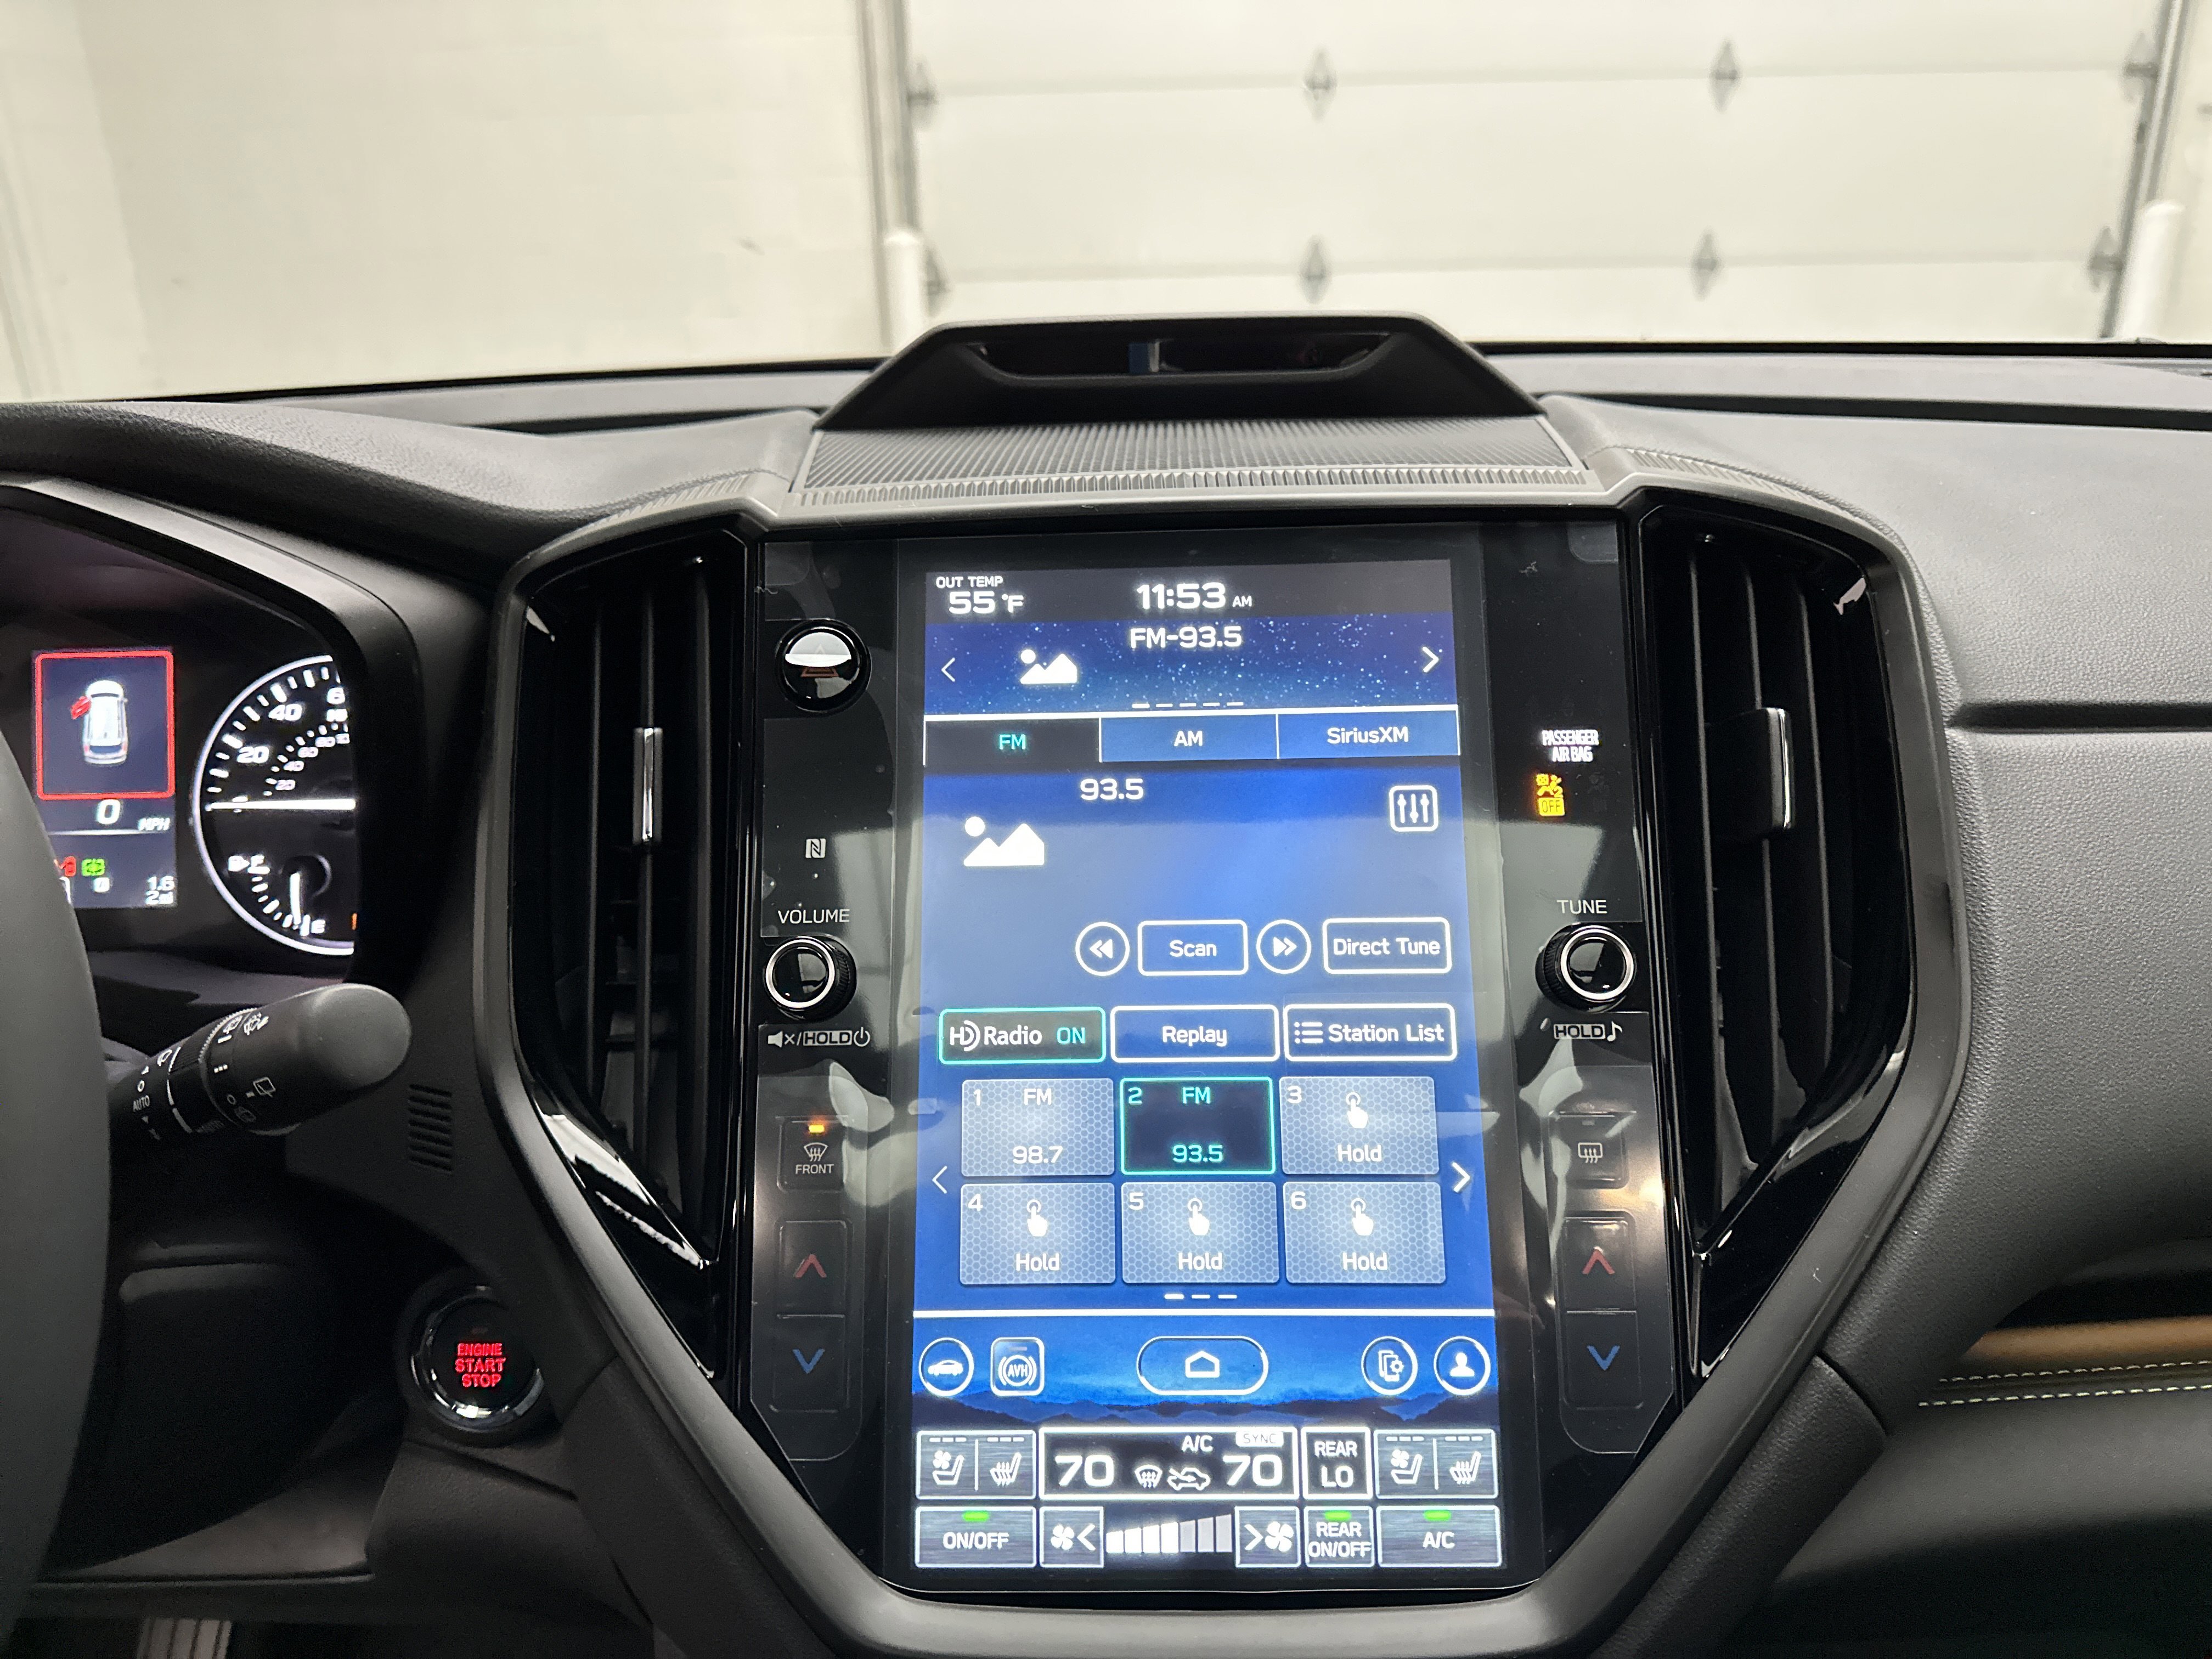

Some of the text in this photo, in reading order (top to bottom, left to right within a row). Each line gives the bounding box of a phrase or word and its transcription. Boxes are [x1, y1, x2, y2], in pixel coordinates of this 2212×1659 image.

[935, 575, 1003, 589] OUT TEMP
[949, 590, 996, 614] 55
[1136, 582, 1252, 610] 11:53 AM
[1130, 625, 1242, 649] FM-93.5
[268, 703, 302, 721] 40
[999, 733, 1026, 750] FM
[1173, 730, 1203, 747] AM
[1327, 726, 1409, 744] SiriusXM
[1542, 729, 1599, 746] PASSENGER
[237, 746, 270, 764] 20
[1552, 746, 1593, 762] AIR BAG
[1080, 778, 1144, 800] 93.5
[96, 799, 121, 825] 0
[1542, 800, 1561, 813] OFF
[138, 817, 171, 831] MPH
[1556, 899, 1607, 915] TUNE
[777, 909, 850, 924] VOLUME
[1170, 940, 1217, 957] Scan
[1333, 937, 1441, 956] Direct Tune
[805, 1031, 850, 1045] HOLD
[984, 1024, 1042, 1046] Radio
[1057, 1026, 1086, 1045] ON
[1162, 1025, 1227, 1047] Replay
[1328, 1024, 1444, 1042] Station List
[1555, 1025, 1604, 1038] HOLD
[132, 1095, 151, 1112] AUTO
[973, 1088, 981, 1107] 1
[1023, 1088, 1052, 1105] FM
[1128, 1087, 1143, 1104] 2
[1182, 1086, 1211, 1104] FM
[1285, 1085, 1302, 1104] 3
[1012, 1145, 1063, 1164] 98.7
[1172, 1144, 1223, 1163] 93.5
[1337, 1143, 1383, 1163] Hold
[795, 1164, 834, 1175] FRONT
[968, 1193, 984, 1211] 4
[1127, 1191, 1144, 1210] 5
[1290, 1191, 1307, 1210] 6
[1015, 1251, 1060, 1272] Hold
[1178, 1250, 1223, 1271] Hold
[1342, 1250, 1388, 1271] Hold
[457, 1342, 503, 1356] ENGINE
[455, 1358, 506, 1372] START
[1008, 1364, 1028, 1377] AVH
[461, 1373, 502, 1387] STOP
[1181, 1435, 1214, 1453] A/C
[1243, 1434, 1277, 1444] SYNC
[1314, 1440, 1358, 1457] REAR
[1054, 1453, 1115, 1487] 70
[1222, 1453, 1283, 1487] 70
[1321, 1465, 1354, 1488] LO
[1316, 1521, 1362, 1537] REAR
[943, 1531, 1009, 1550] ON/OFF
[1423, 1531, 1455, 1549] A/C
[1308, 1541, 1372, 1558] ON/OFF
